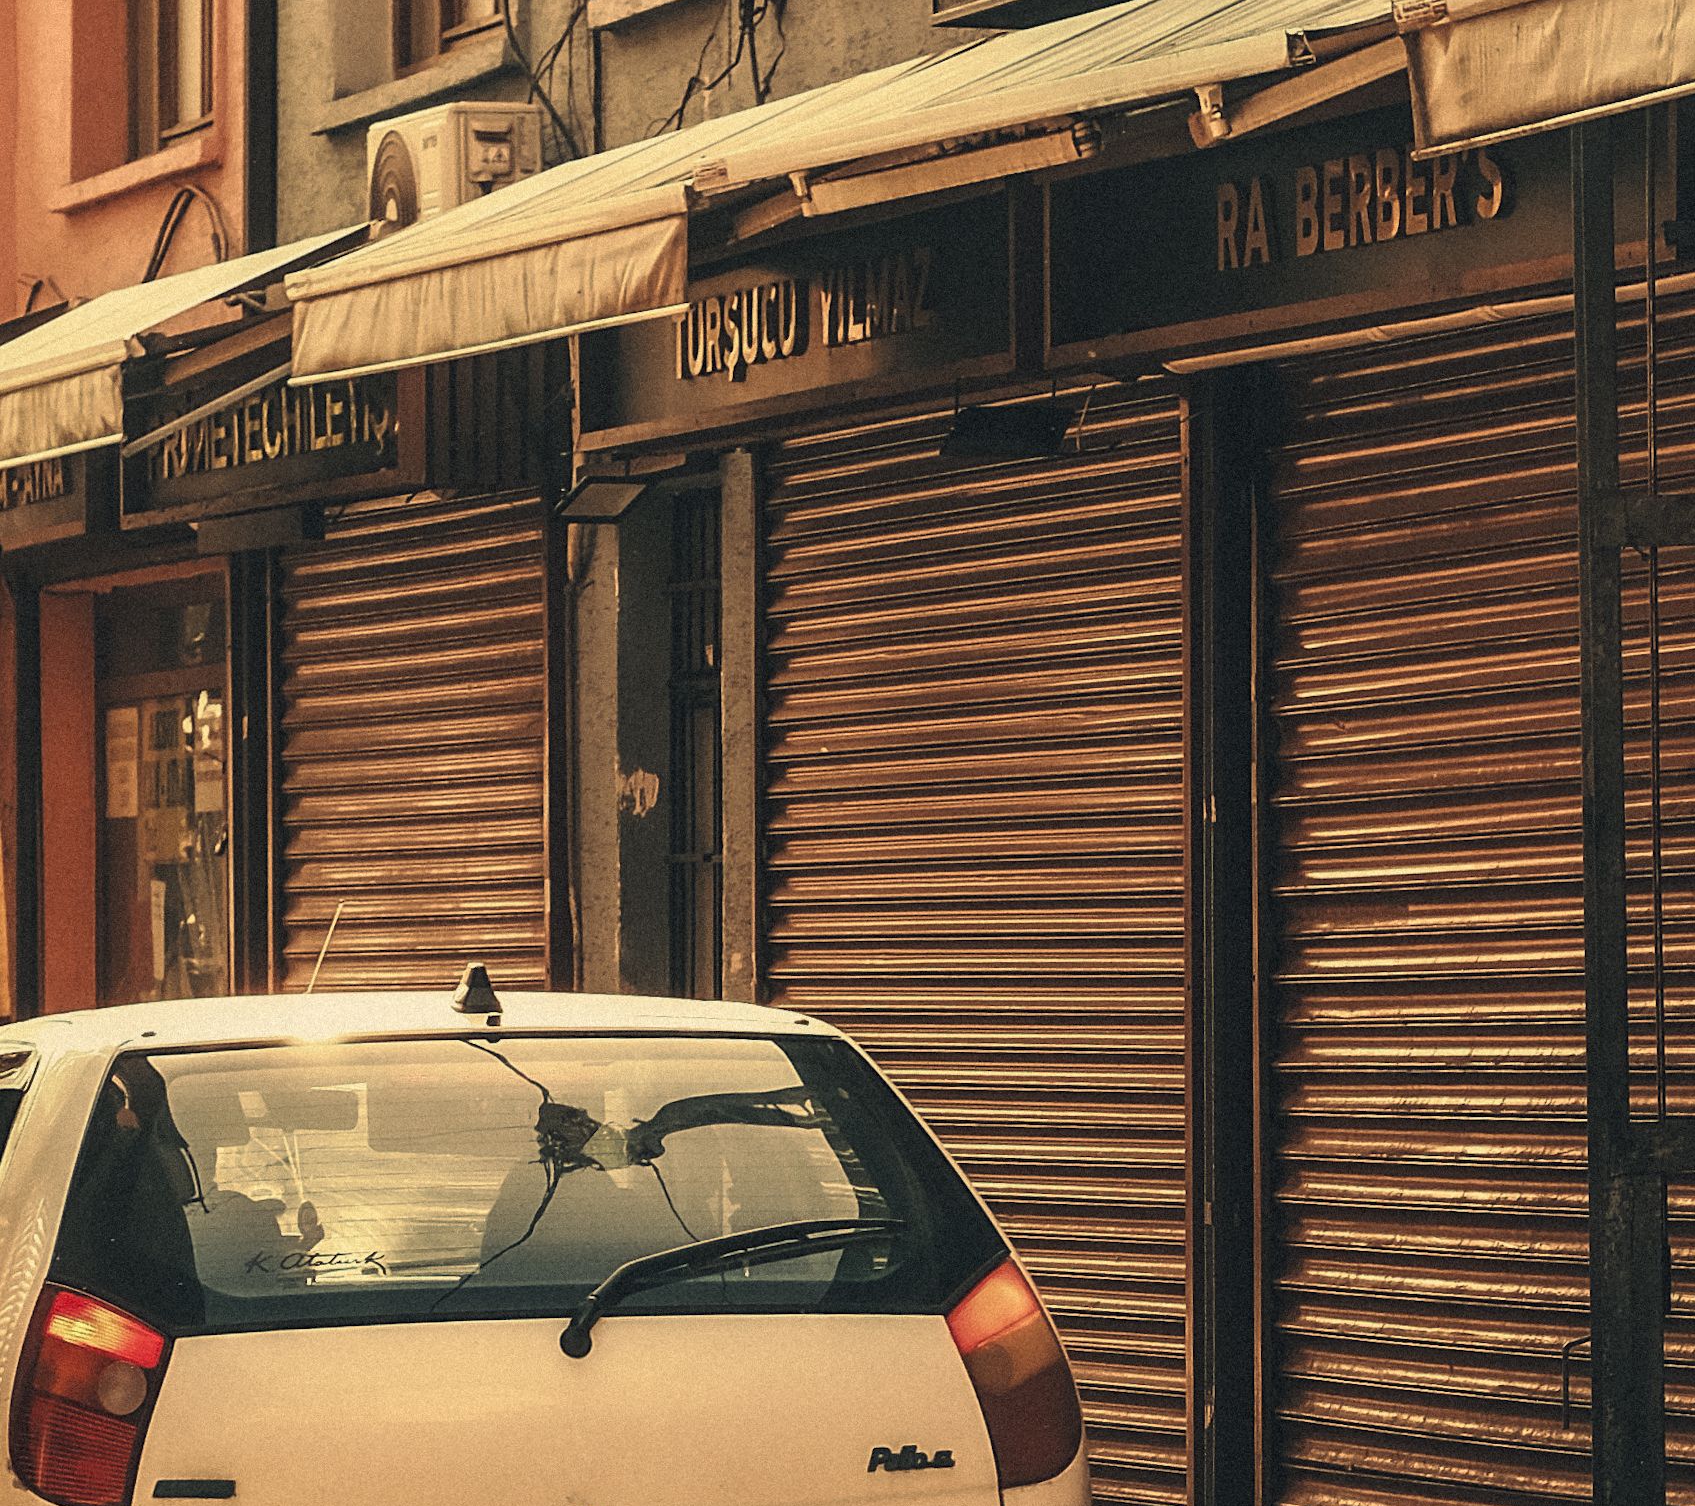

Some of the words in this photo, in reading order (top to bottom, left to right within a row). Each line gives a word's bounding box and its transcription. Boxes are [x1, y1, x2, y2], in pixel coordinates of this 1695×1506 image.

[1217, 176, 1270, 271] RA
[1296, 147, 1502, 257] BERBER'S
[673, 279, 796, 382] TURŞUCU
